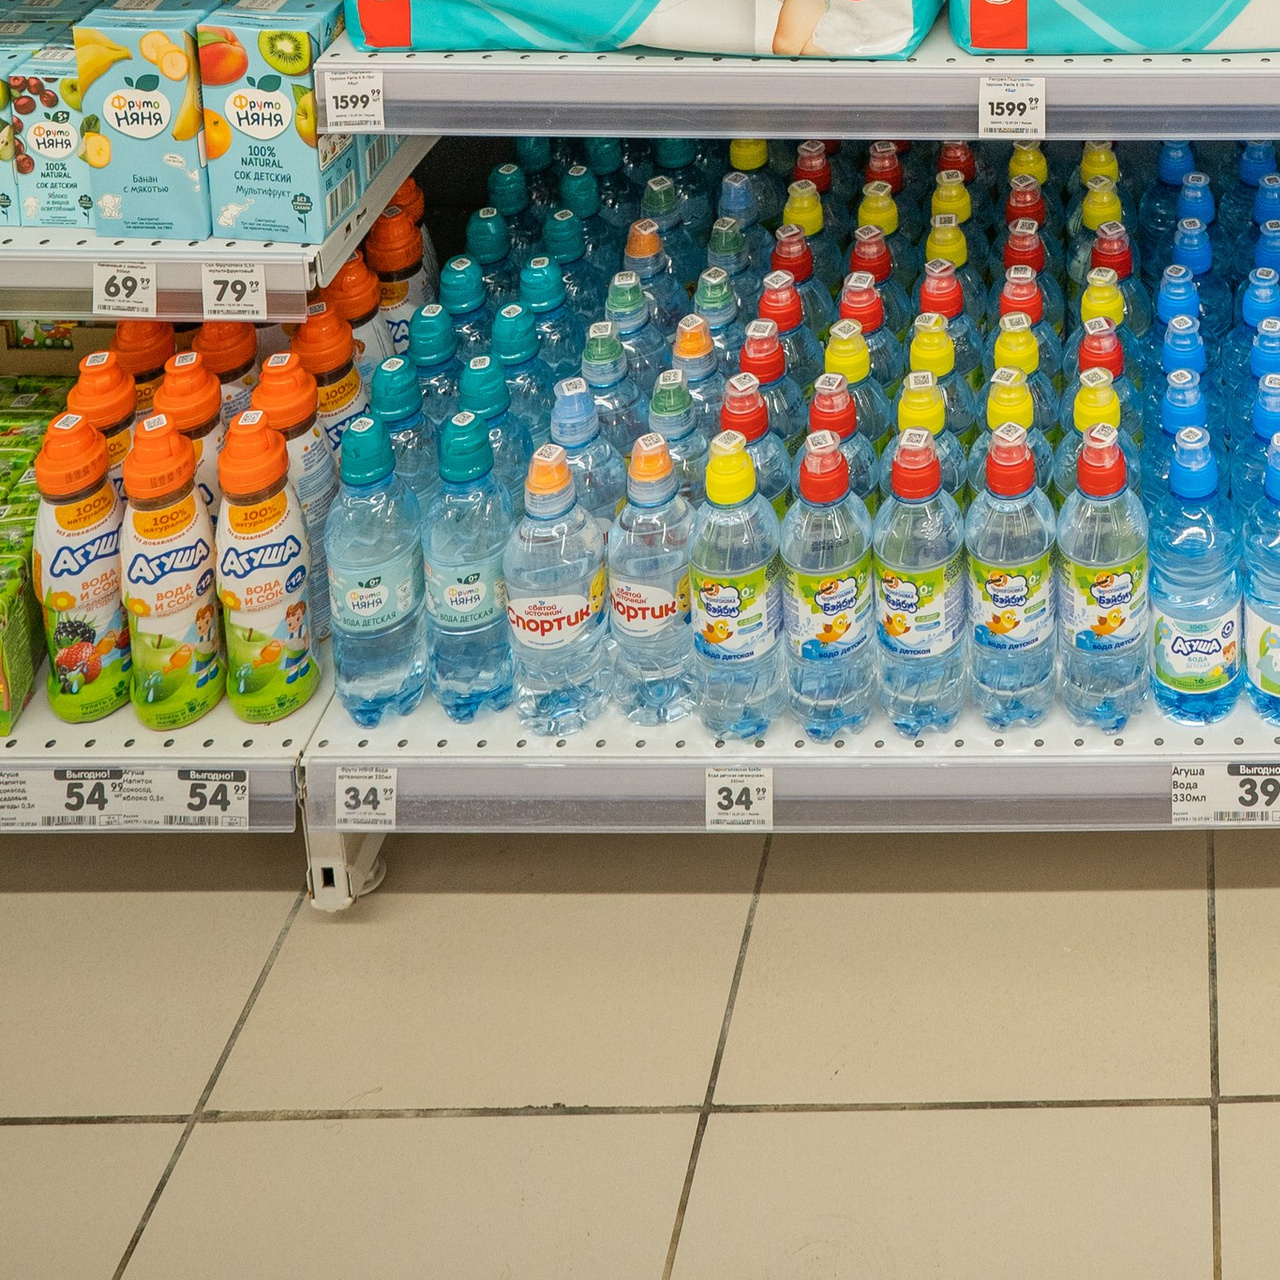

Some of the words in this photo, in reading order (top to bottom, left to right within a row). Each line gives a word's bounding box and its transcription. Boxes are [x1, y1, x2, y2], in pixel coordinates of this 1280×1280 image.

[332, 94, 369, 110] 1599
[235, 171, 250, 182] СОК
[254, 171, 291, 183] ДЕТСКИЙ
[236, 186, 290, 199] Мультифрукт
[104, 277, 137, 298] 69
[1173, 767, 1204, 778] Агуша
[187, 783, 230, 811] 54
[345, 787, 380, 810] 34
[1173, 794, 1206, 803] 330мл
[1238, 778, 1280, 806] 39
